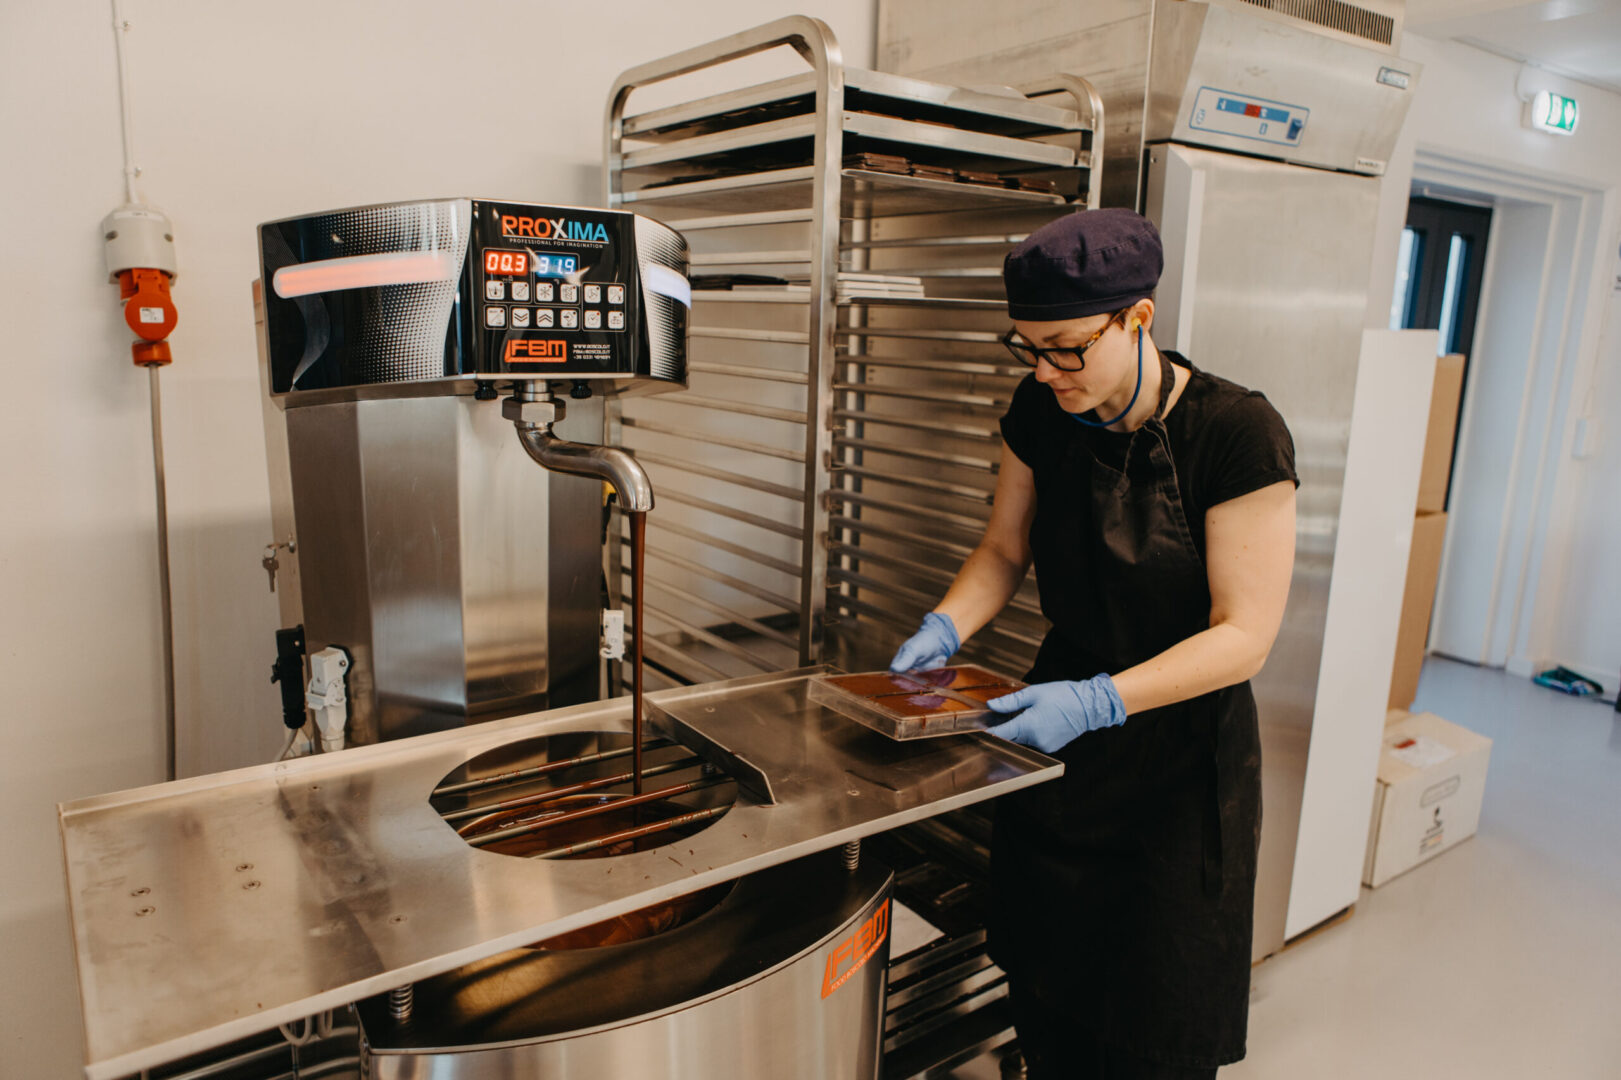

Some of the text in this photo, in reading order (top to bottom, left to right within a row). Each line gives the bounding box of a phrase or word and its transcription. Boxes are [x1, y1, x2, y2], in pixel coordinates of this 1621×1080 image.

[501, 215, 609, 242] PROXIMA
[509, 238, 552, 246] PROFESSIONAL
[566, 241, 604, 249] IMAGINATION
[507, 340, 567, 360] FBM
[826, 897, 889, 990] FBM
